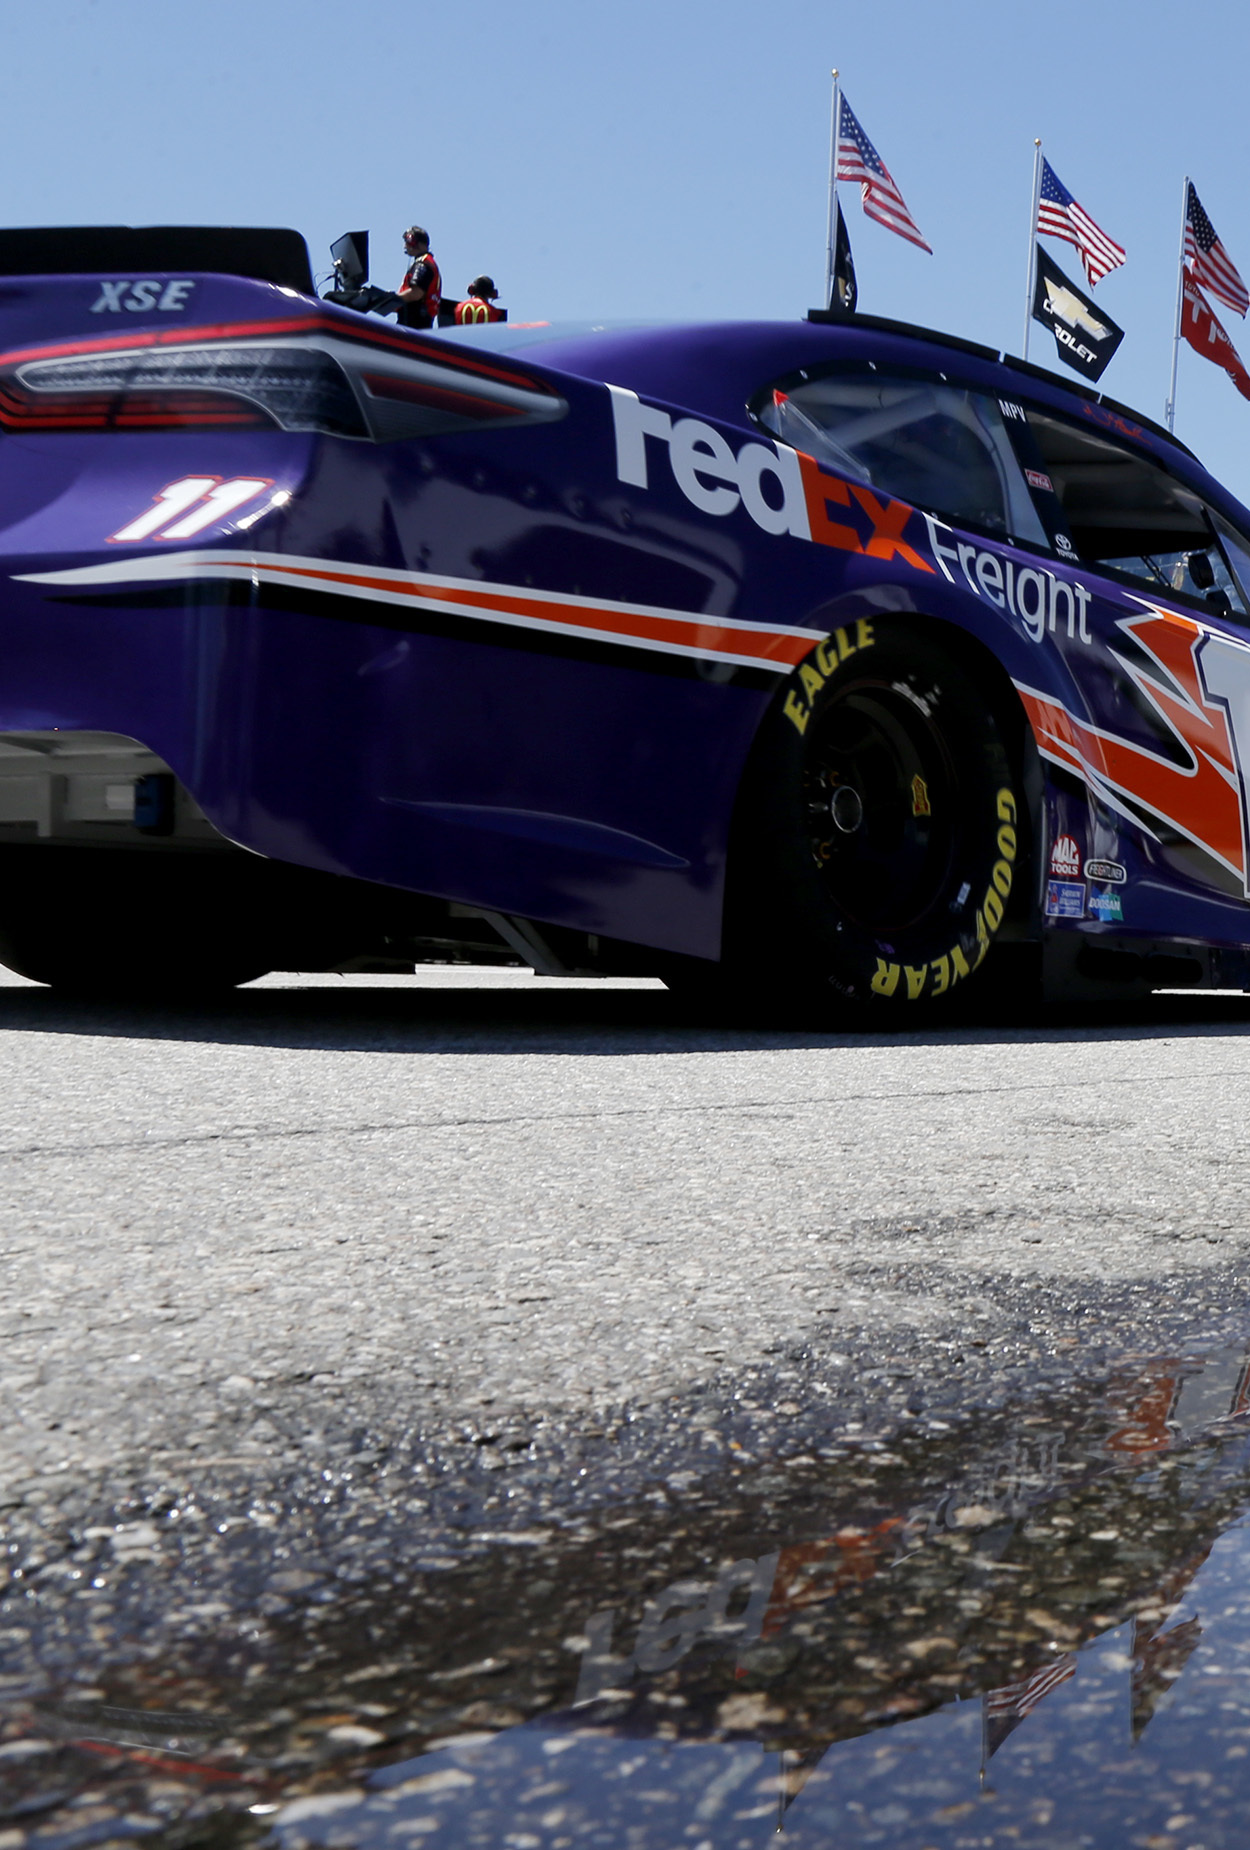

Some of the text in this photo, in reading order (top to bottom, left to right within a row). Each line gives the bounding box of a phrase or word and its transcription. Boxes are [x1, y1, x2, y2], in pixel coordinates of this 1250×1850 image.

[89, 280, 196, 314] XSE
[998, 399, 1027, 422] MPV
[106, 474, 275, 544] 11
[922, 511, 1093, 645] Freight
[783, 616, 876, 736] EAGLE
[1051, 862, 1079, 875] TOOLS
[1052, 837, 1079, 865] MAC
[870, 787, 1017, 1000] GOODYEAR
